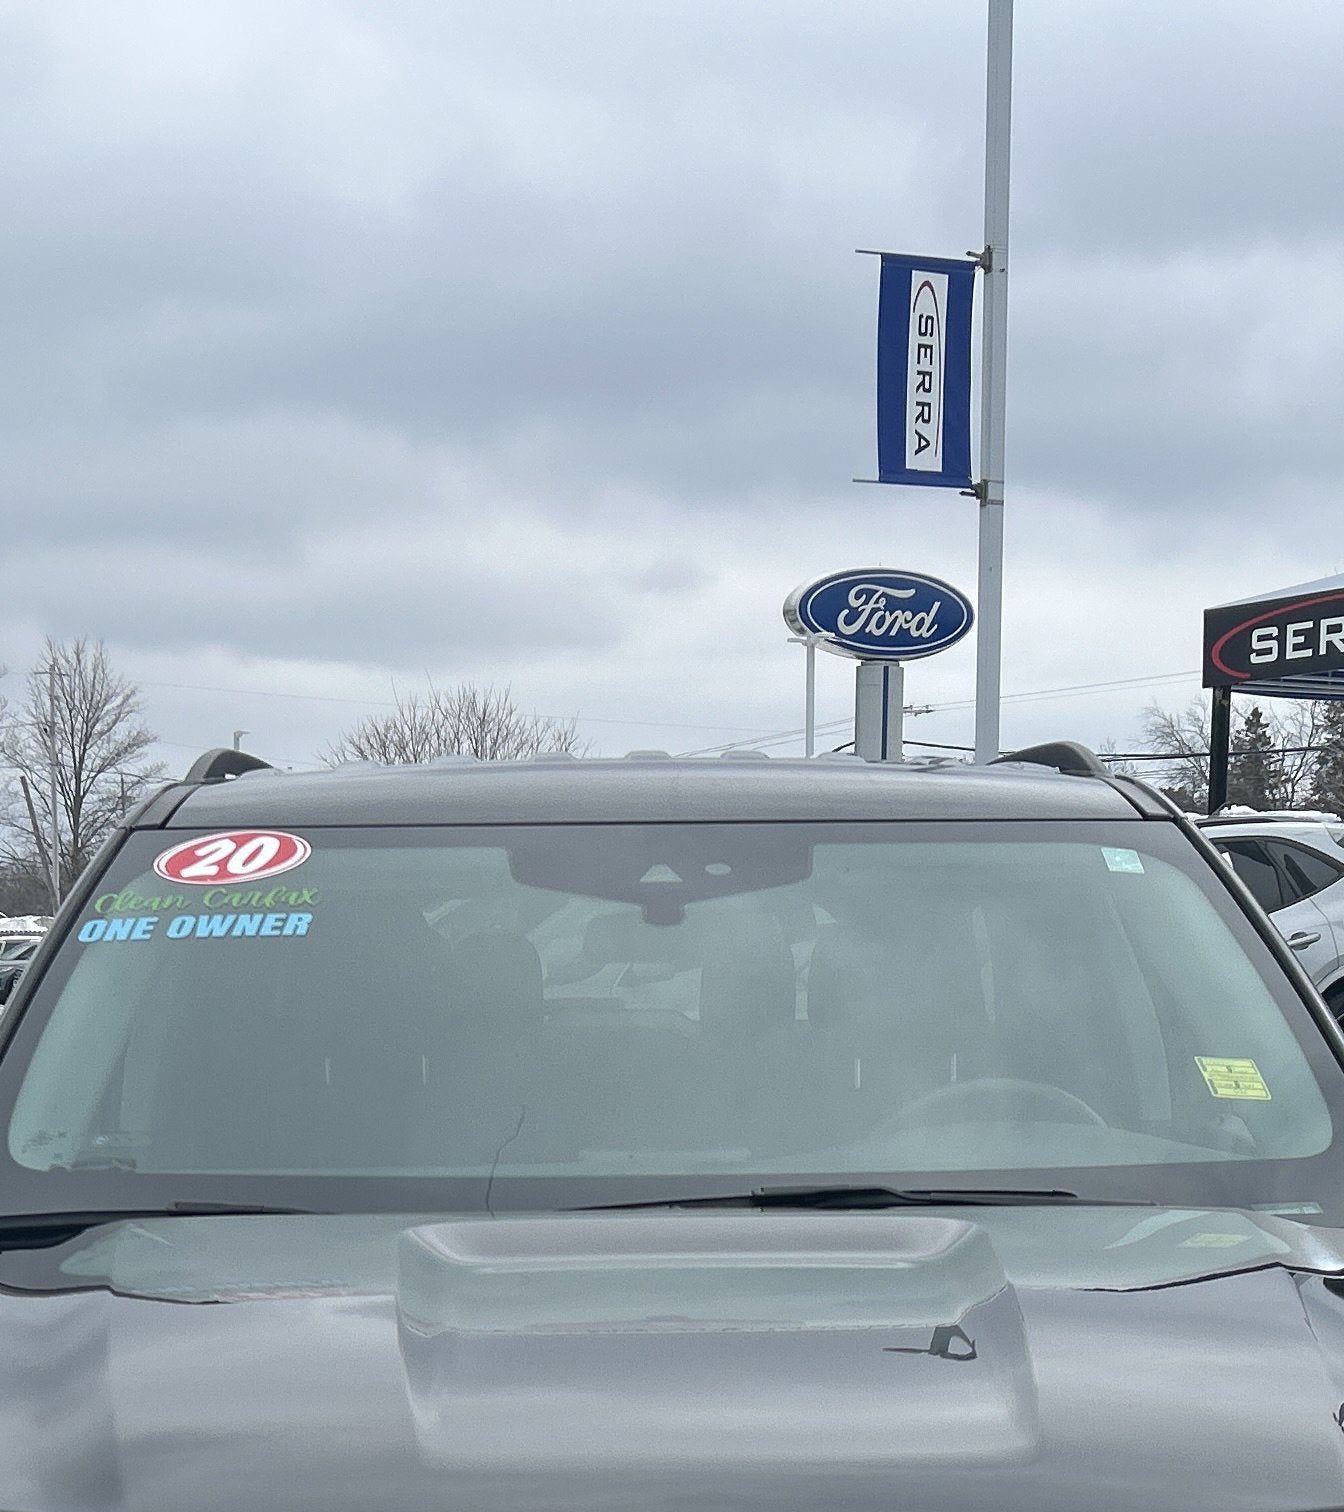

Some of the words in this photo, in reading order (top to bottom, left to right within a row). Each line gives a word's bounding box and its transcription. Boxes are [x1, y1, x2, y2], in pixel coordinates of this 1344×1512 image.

[914, 312, 935, 456] SERRA
[836, 583, 942, 638] Ford
[179, 835, 281, 878] 20
[94, 891, 190, 914] Clean
[203, 886, 319, 909] Carfax
[77, 916, 159, 943] ONE
[166, 912, 313, 939] OWNER
